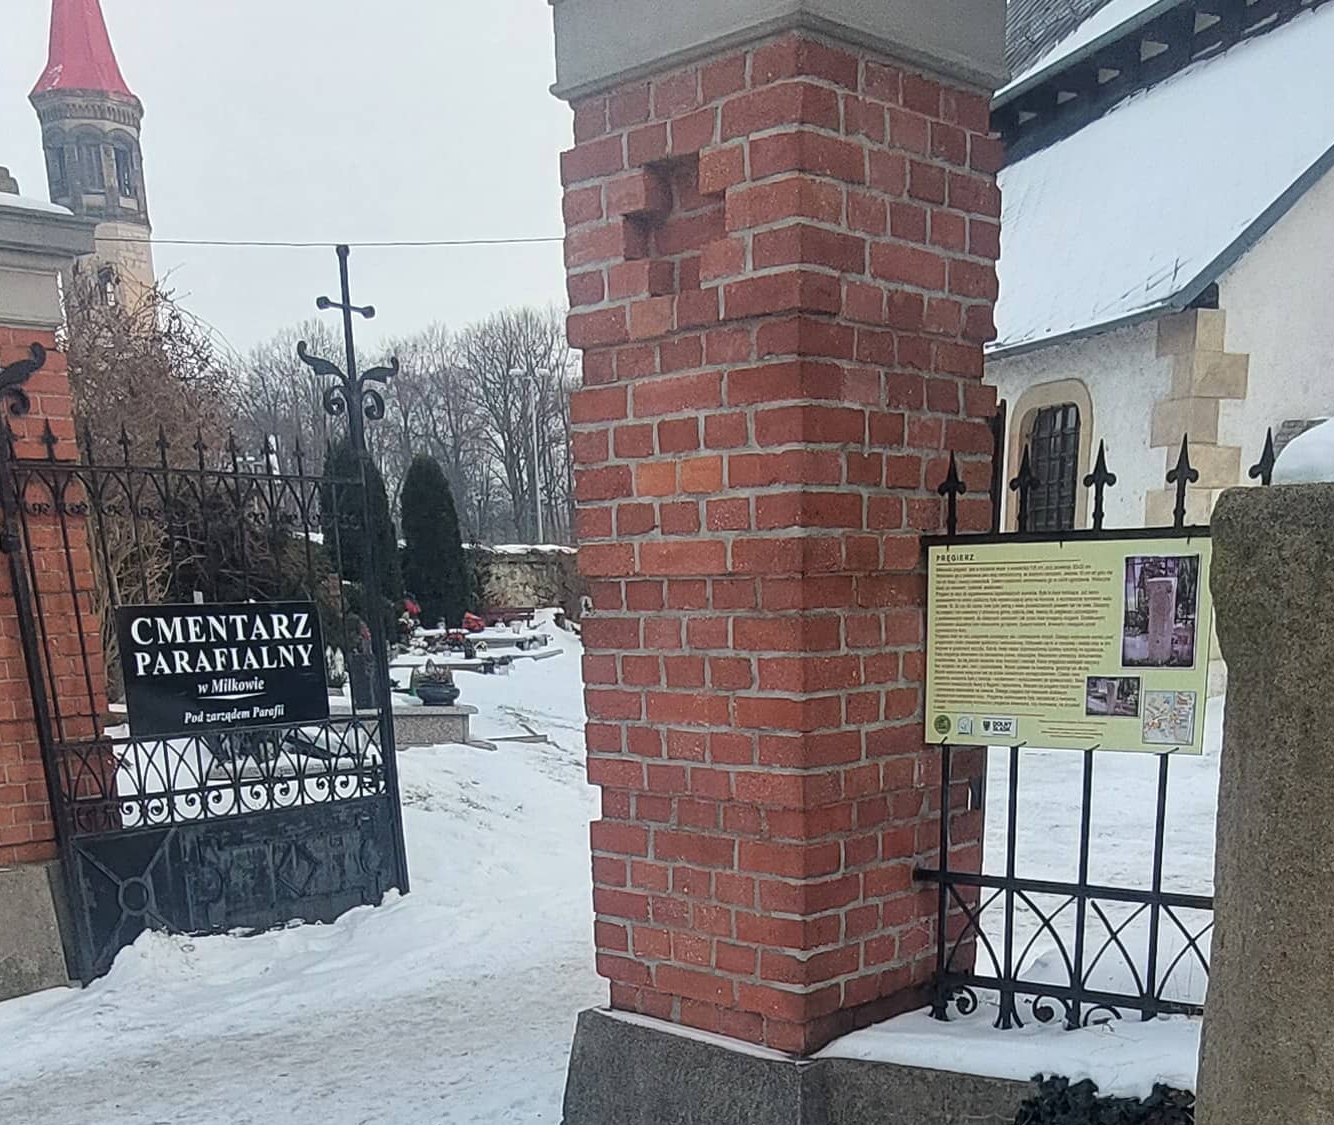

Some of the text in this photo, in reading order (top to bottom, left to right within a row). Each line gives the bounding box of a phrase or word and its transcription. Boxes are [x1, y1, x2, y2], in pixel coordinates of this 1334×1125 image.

[131, 613, 312, 645] CMENTARZ
[134, 644, 314, 676] PARAFIALNY
[197, 683, 209, 694] w
[184, 710, 204, 724] Pod
[252, 703, 285, 719] Parafii
